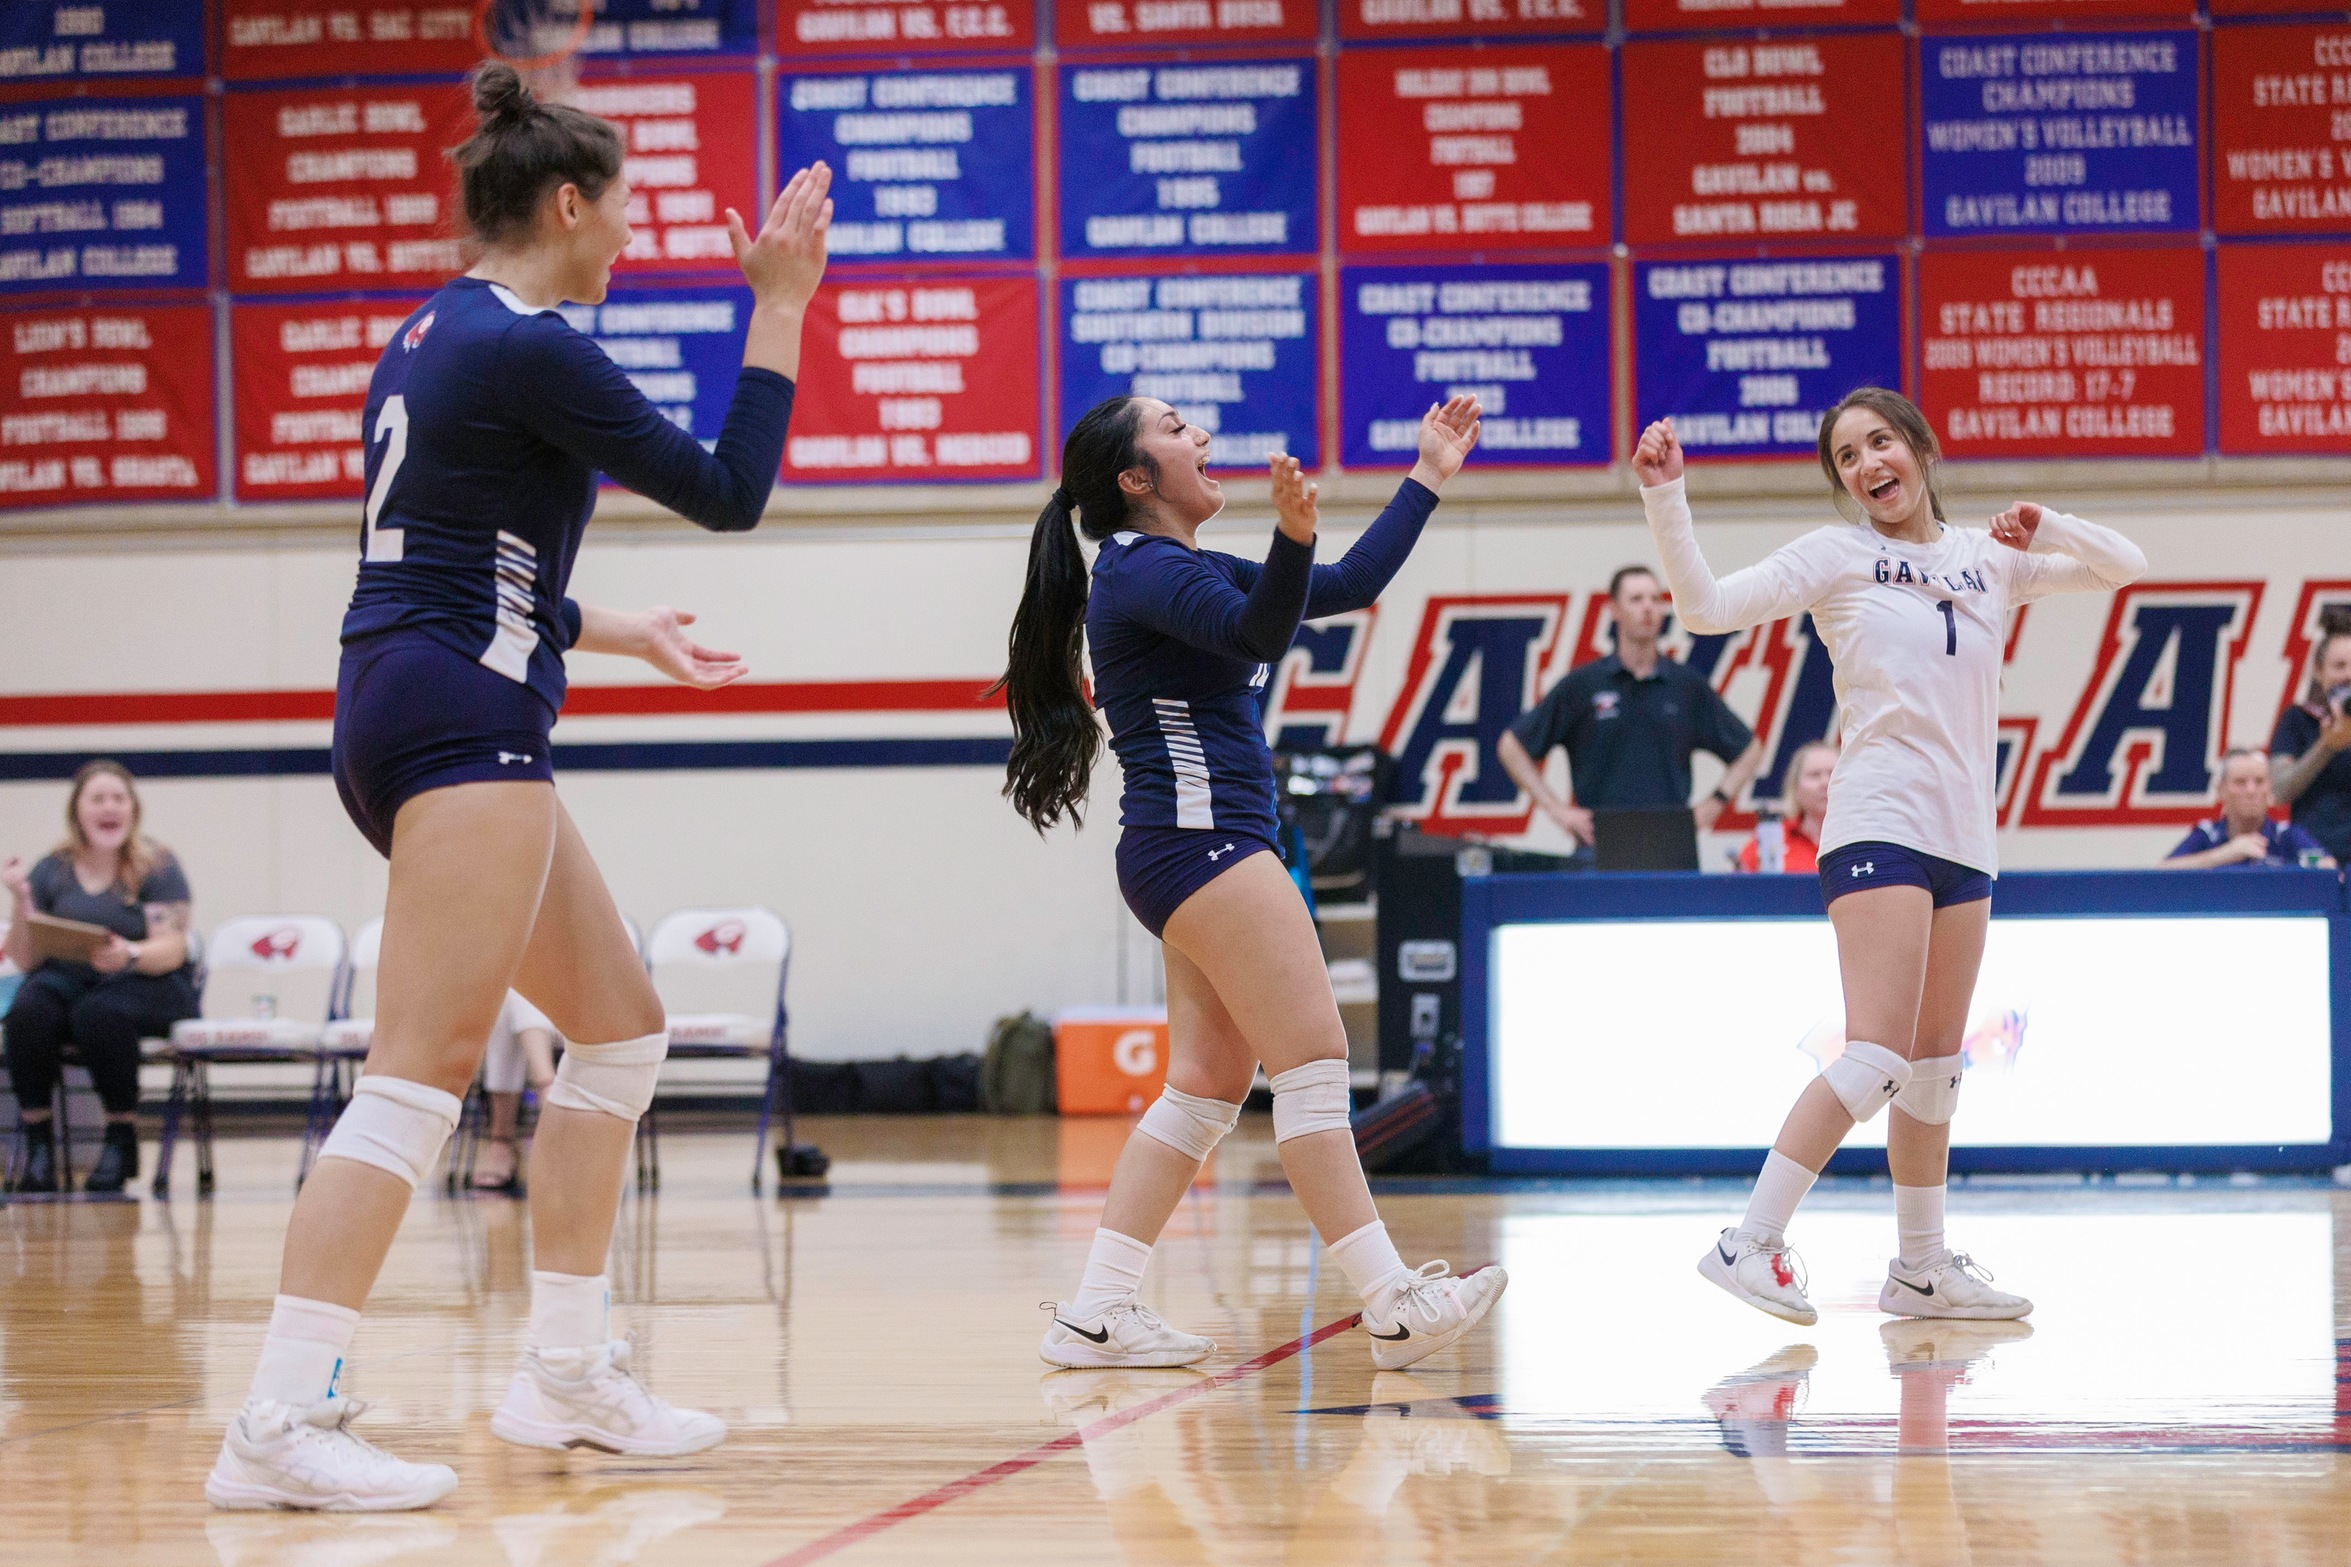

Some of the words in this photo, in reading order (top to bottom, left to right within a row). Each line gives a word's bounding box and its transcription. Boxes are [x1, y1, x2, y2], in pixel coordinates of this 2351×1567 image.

[0, 46, 74, 76] AVILAN
[1940, 46, 2017, 78] COAST
[2021, 43, 2176, 75] CONFERENCE
[1704, 86, 1824, 116] FOOTBALL
[1983, 79, 2134, 111] CHAMPIONS
[2254, 75, 2326, 106] STATE
[2042, 116, 2191, 148] VOLLEYBALL
[1693, 164, 1799, 194] GAVILAN
[1946, 195, 2059, 227] GAVILAN
[2063, 191, 2171, 223] COLLEGE
[0, 249, 76, 280] AVILAN
[1648, 267, 1726, 298] COAST
[1729, 263, 1883, 295] CONFERENCE
[2012, 266, 2098, 297] CCCAA
[1359, 283, 1435, 314] COAST
[1438, 282, 1590, 313] CONFERENCE
[2258, 297, 2331, 329] STATE
[1387, 317, 1562, 348] CO-CHAMPIONS
[1678, 300, 1855, 333] CO-CHAMPIONS
[1940, 302, 2024, 334] STATE
[2035, 300, 2173, 332] REGIONALS
[1415, 350, 1536, 381] FOOTBALL
[1707, 339, 1829, 370] FOOTBALL
[2071, 335, 2199, 366] VOLLEYBALL
[1948, 408, 2061, 439] GAVILAN
[2066, 406, 2174, 437] COLLEGE
[365, 394, 409, 563] 2
[1936, 600, 1957, 656] 1
[1113, 1029, 1157, 1077] G
